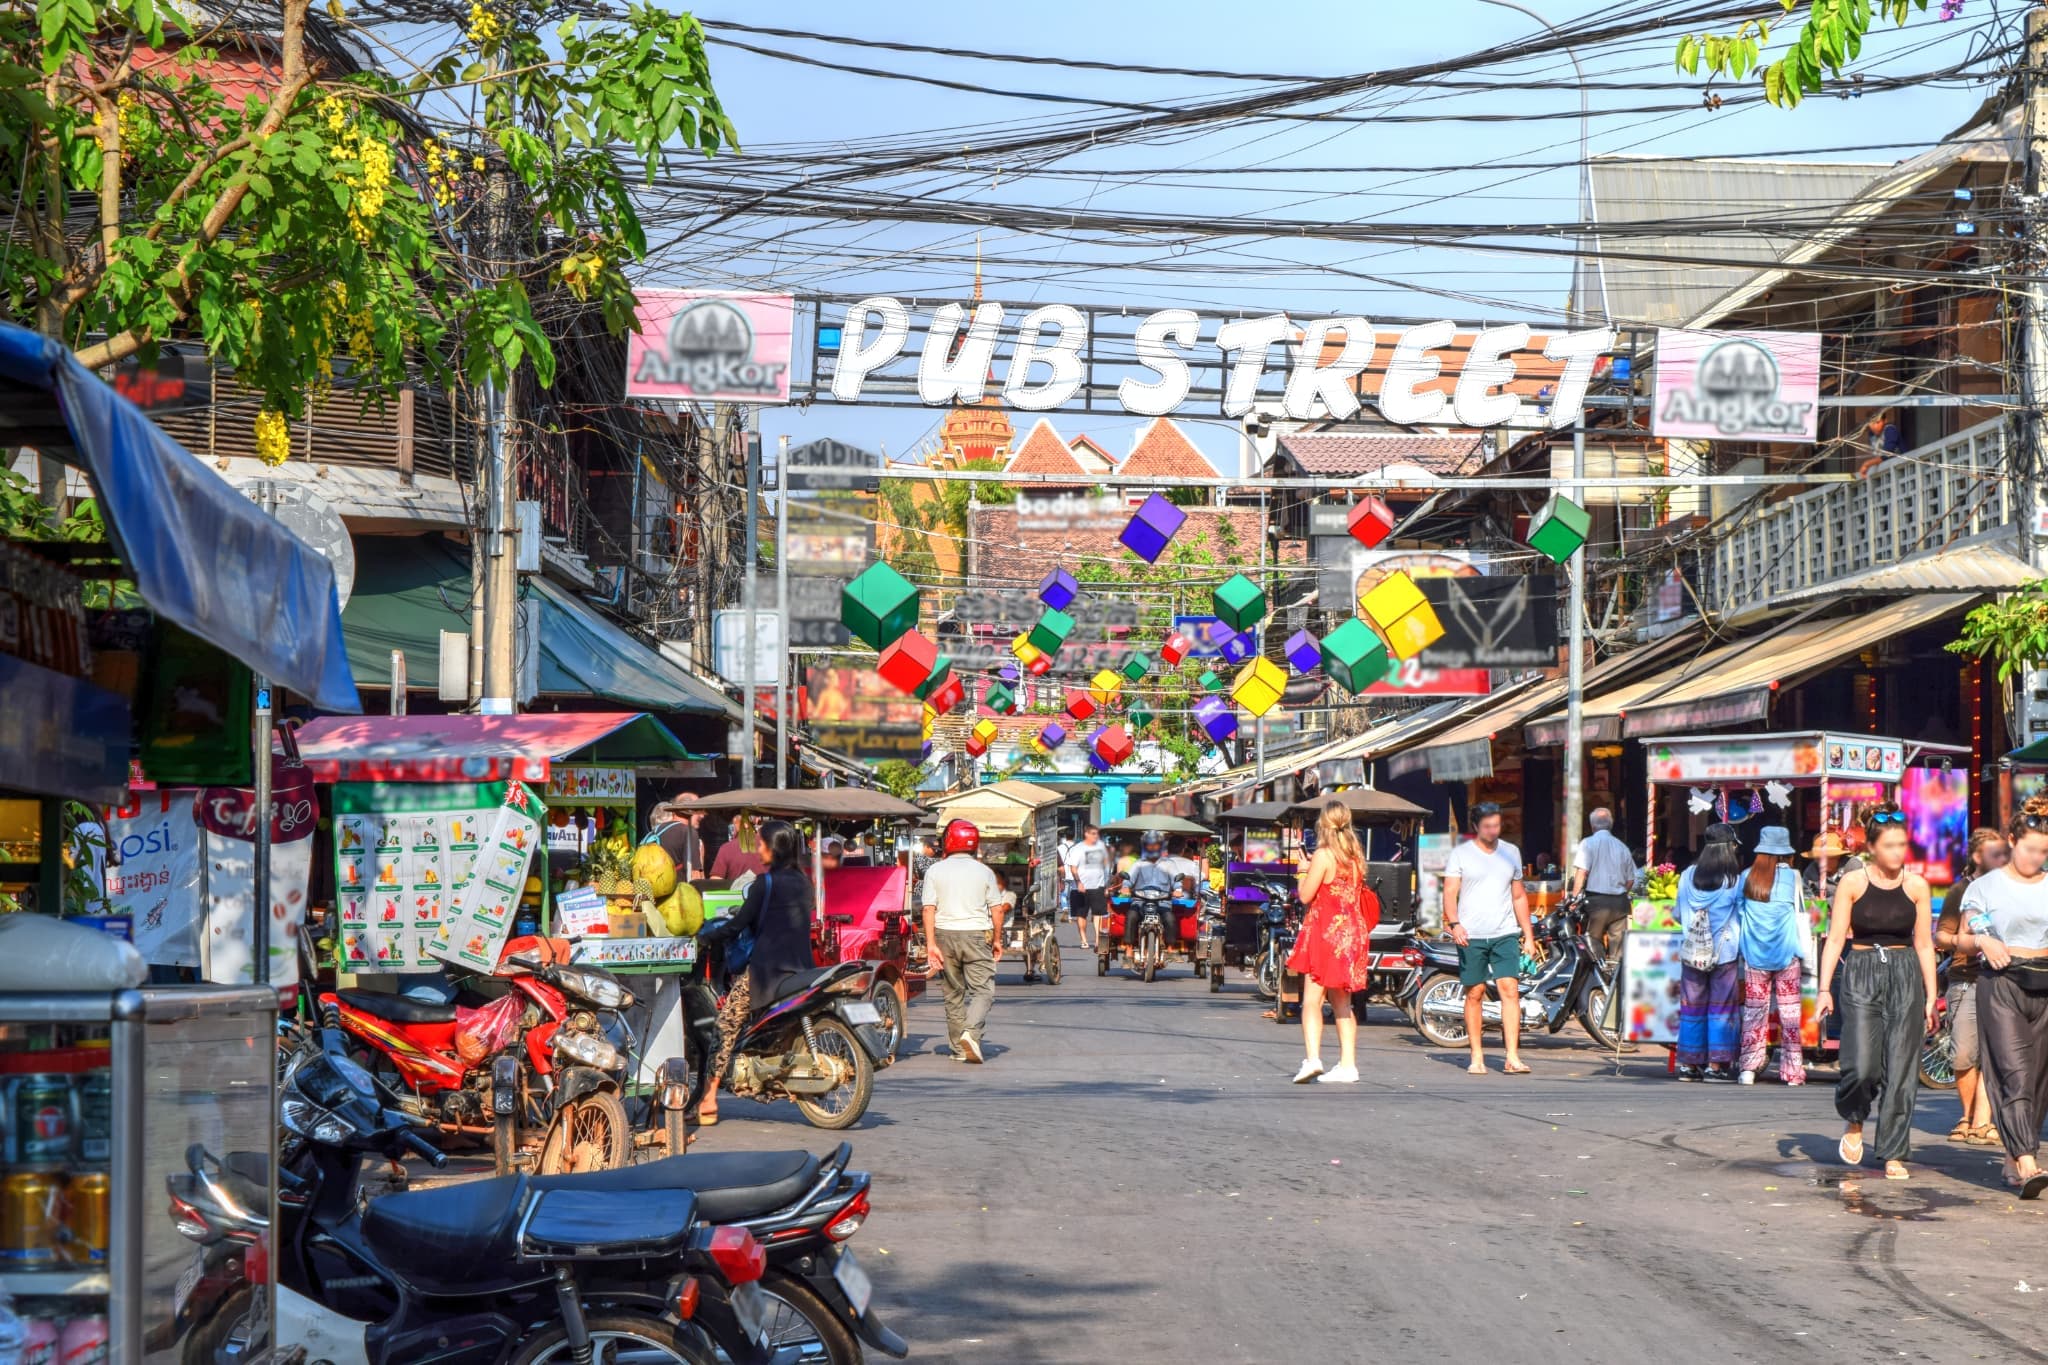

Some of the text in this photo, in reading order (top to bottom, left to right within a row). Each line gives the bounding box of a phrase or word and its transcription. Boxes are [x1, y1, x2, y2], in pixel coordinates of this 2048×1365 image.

[634, 349, 787, 396] Angkor
[831, 297, 1618, 431] PUB STREET
[1661, 388, 1814, 435] Angkor
[111, 821, 171, 866] psi
